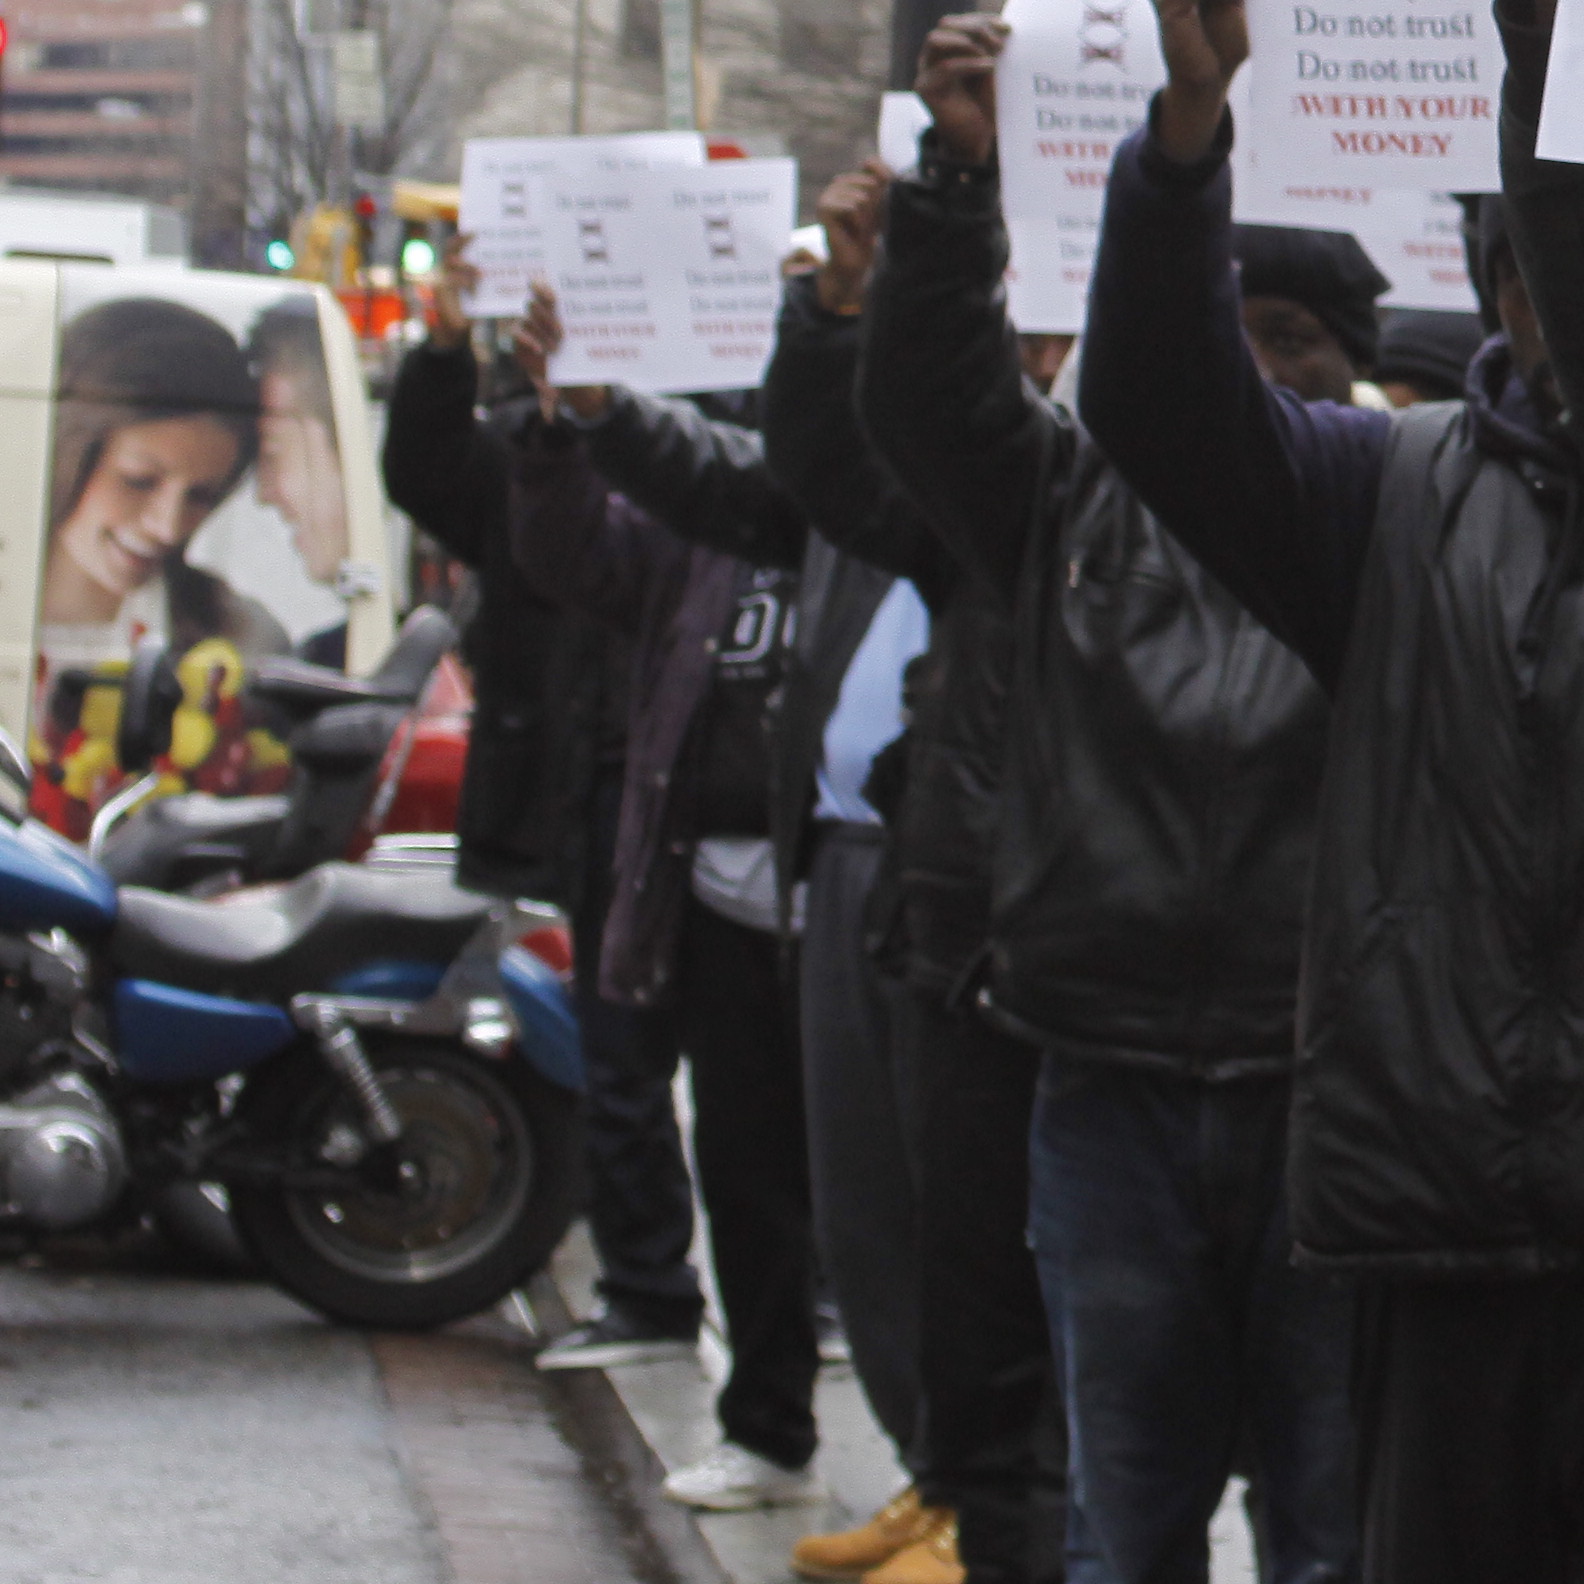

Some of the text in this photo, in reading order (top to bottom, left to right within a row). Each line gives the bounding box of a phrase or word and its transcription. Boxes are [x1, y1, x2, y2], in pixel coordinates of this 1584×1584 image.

[1293, 7, 1475, 39] Do not trust
[1297, 50, 1478, 83] Do not trust
[1033, 73, 1070, 98] Do
[1076, 79, 1115, 101] not
[1299, 95, 1489, 118] WITH YOUR
[1036, 108, 1072, 132] Do
[1333, 131, 1448, 156] MONEY
